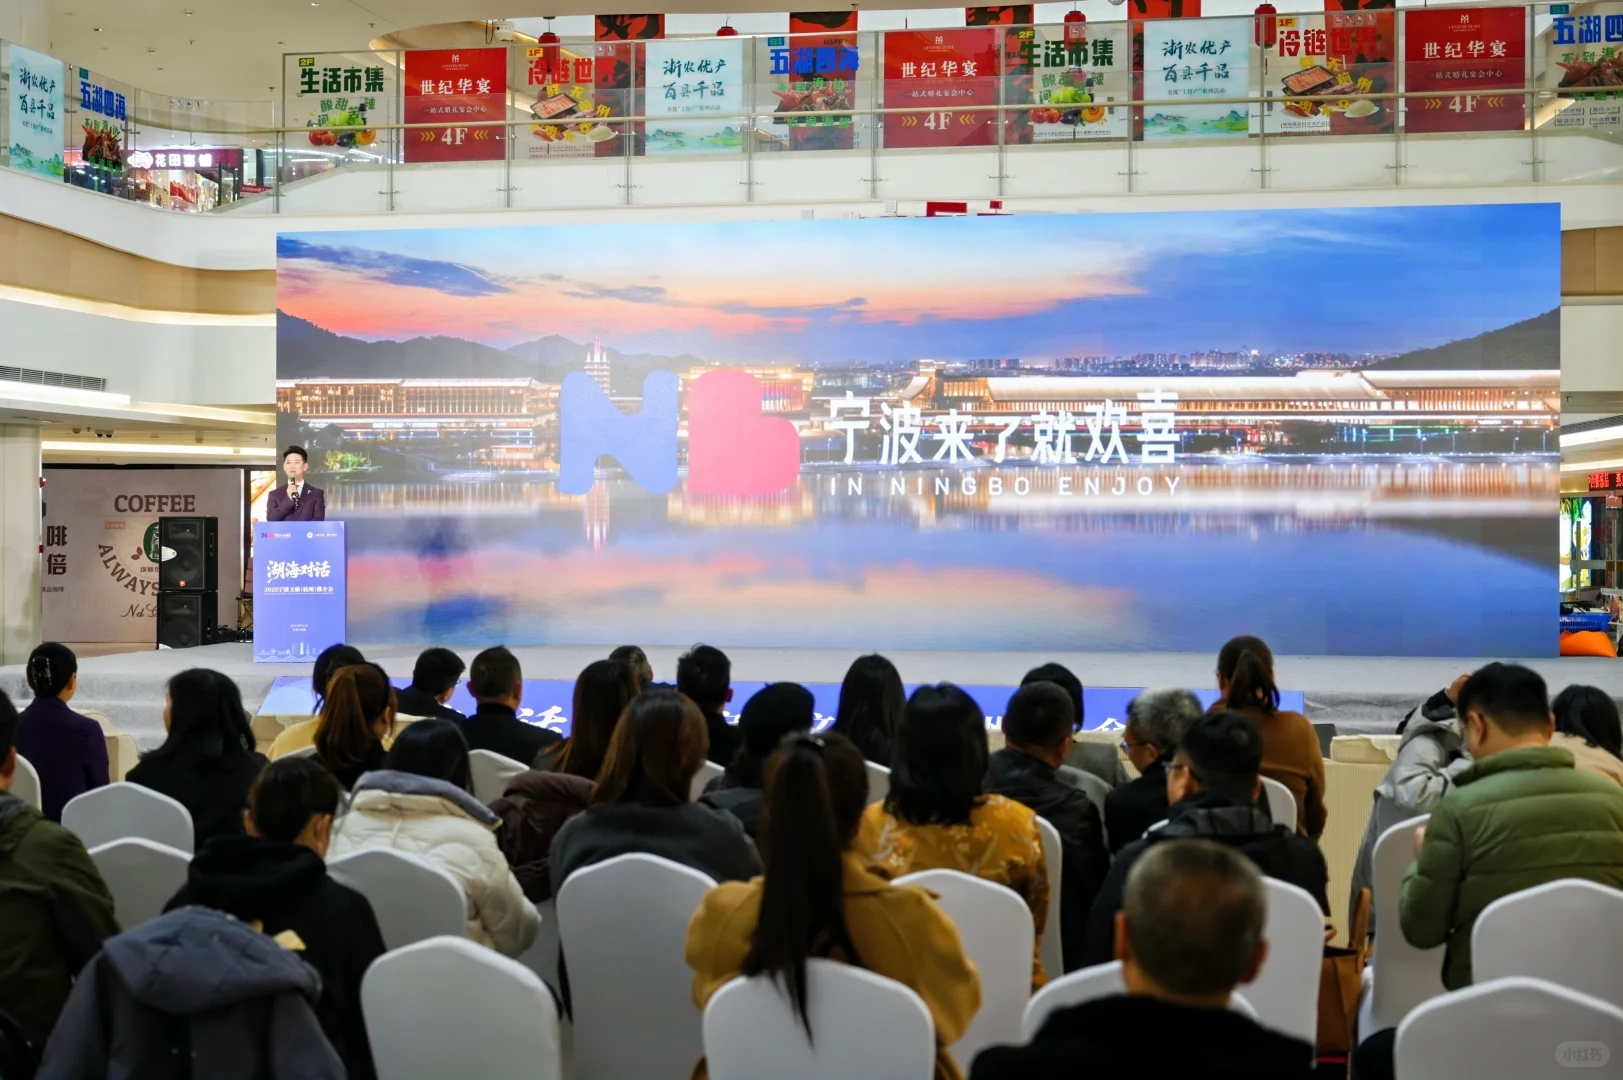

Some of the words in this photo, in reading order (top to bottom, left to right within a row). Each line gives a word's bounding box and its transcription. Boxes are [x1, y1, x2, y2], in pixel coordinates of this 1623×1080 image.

[1279, 19, 1292, 27] 1F
[1021, 38, 1114, 67] 生活市集
[1161, 39, 1231, 60] 浙农优产
[1279, 28, 1377, 57] 冷链世界
[1423, 40, 1507, 59] 世纪华宴
[663, 58, 726, 78] 浙农优产
[901, 60, 978, 78] 世纪华宴
[1163, 62, 1230, 83] 百县千品
[301, 66, 384, 93] 生活市集
[420, 78, 491, 95] 世纪华宴
[663, 80, 725, 100] 百县千品
[80, 81, 126, 121] 五湖四海
[1448, 95, 1480, 113] 4F
[923, 111, 953, 130] 4F
[441, 128, 468, 145] 4F
[829, 386, 1181, 465] 宁波来了就欢喜
[831, 477, 862, 496] IN
[891, 477, 1030, 496] NINGBO
[1059, 477, 1181, 496] ENJOY
[114, 494, 196, 513] COFFEE
[46, 525, 68, 547] 啡
[46, 554, 67, 576] 倍
[98, 543, 160, 597] ALWAYS
[266, 560, 331, 584] 湖海对话
